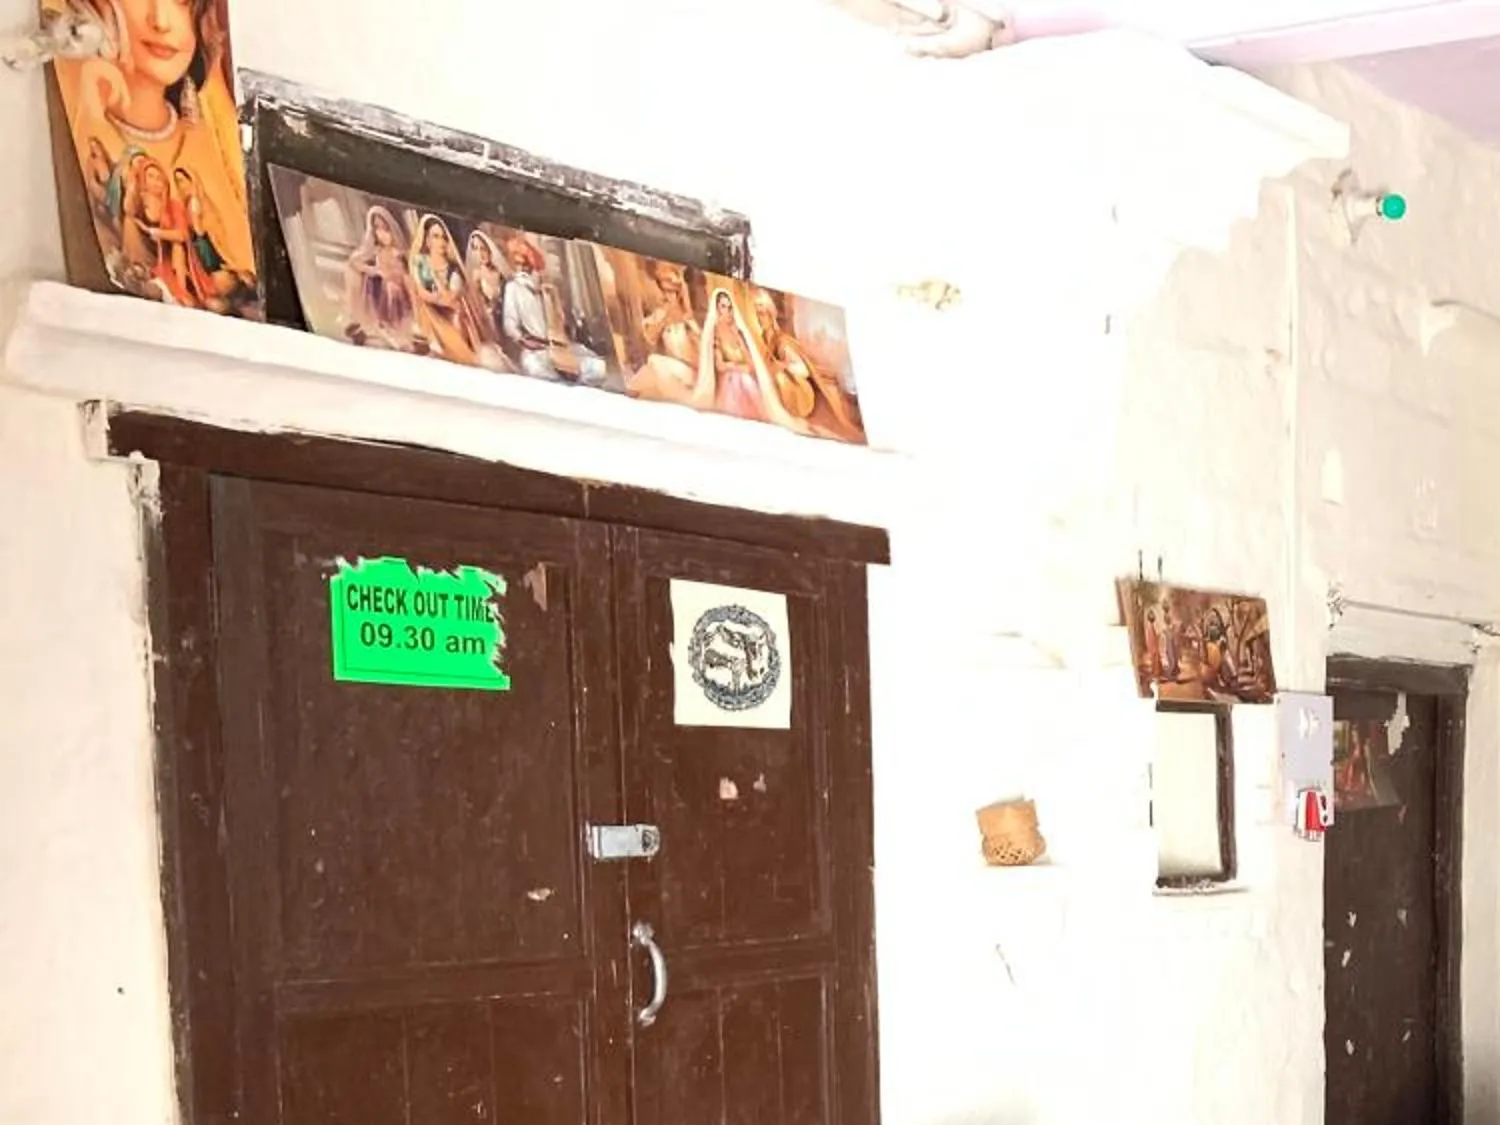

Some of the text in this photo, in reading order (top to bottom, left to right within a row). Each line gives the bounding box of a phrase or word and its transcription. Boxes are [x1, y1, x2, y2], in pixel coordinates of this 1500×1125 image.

[347, 583, 408, 615] CHECK
[413, 591, 449, 619] OUT
[360, 621, 486, 655] 09.30 am
